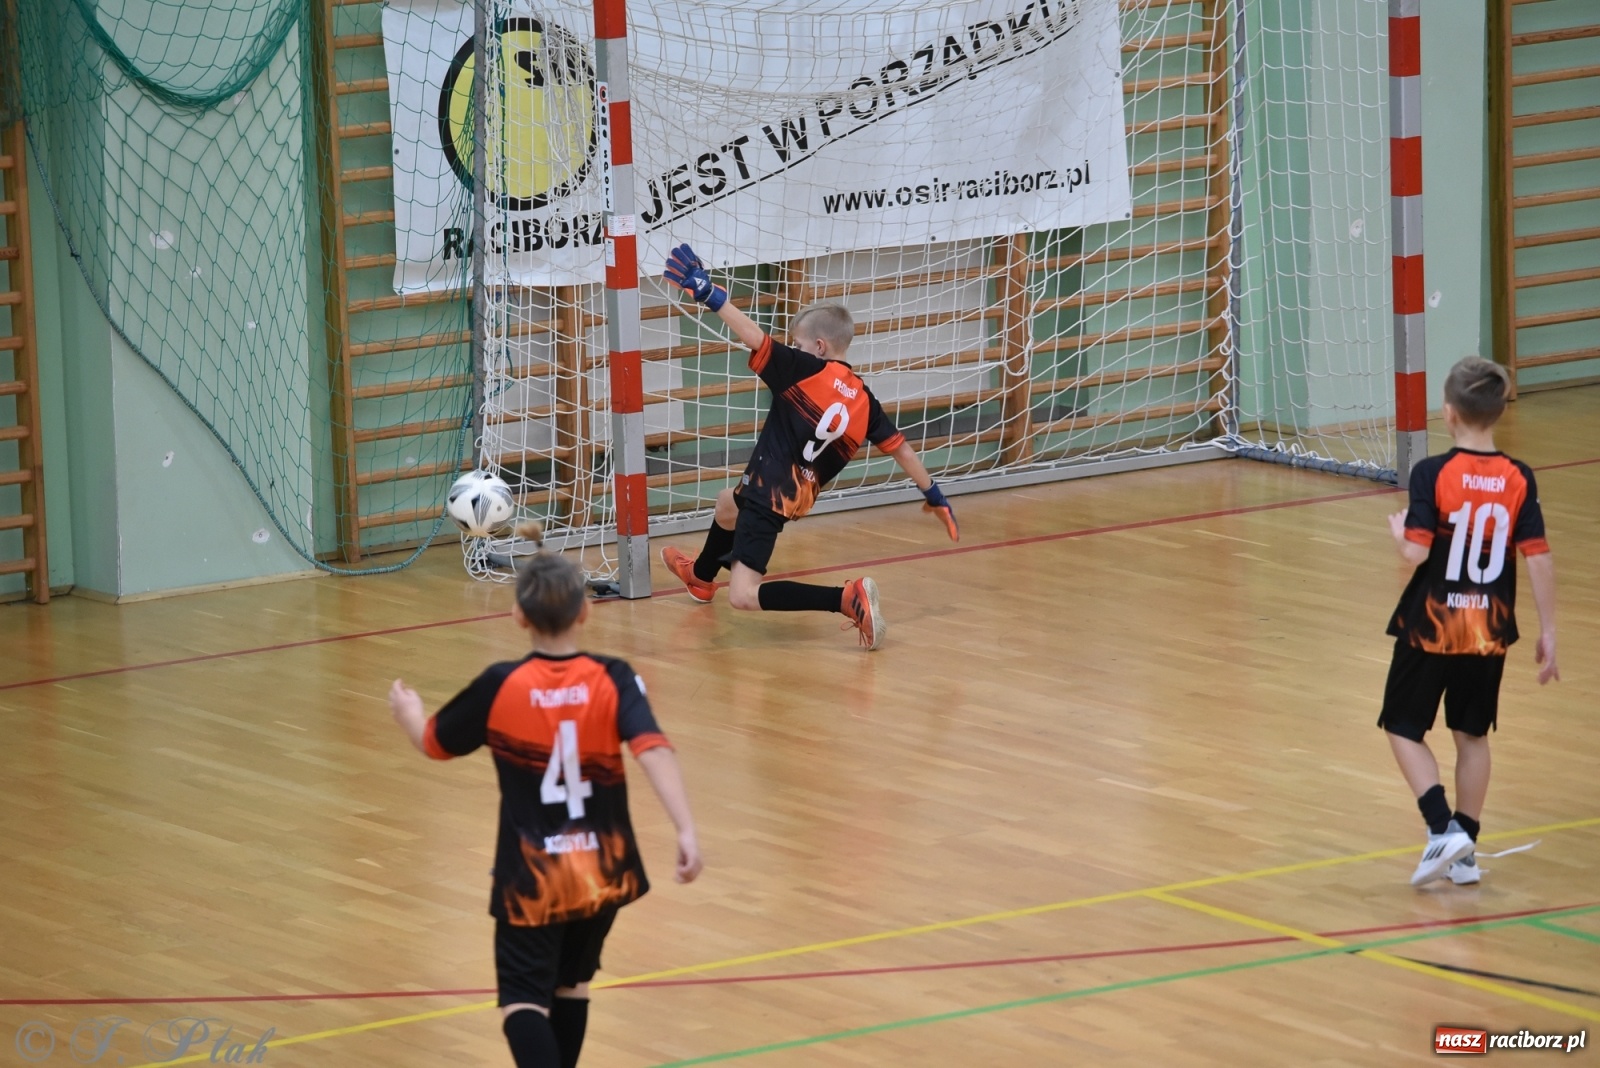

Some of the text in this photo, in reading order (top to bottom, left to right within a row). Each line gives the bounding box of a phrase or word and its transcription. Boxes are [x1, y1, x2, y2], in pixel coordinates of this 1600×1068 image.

[603, 149, 611, 209] sport
[640, 134, 750, 224] JEST
[761, 108, 809, 164] W
[823, 159, 1091, 215] www.osir-raciborz.pl
[443, 208, 605, 260] RCIBÓRZ
[803, 402, 850, 462] 9
[1445, 501, 1510, 584] 10
[540, 720, 593, 820] 4
